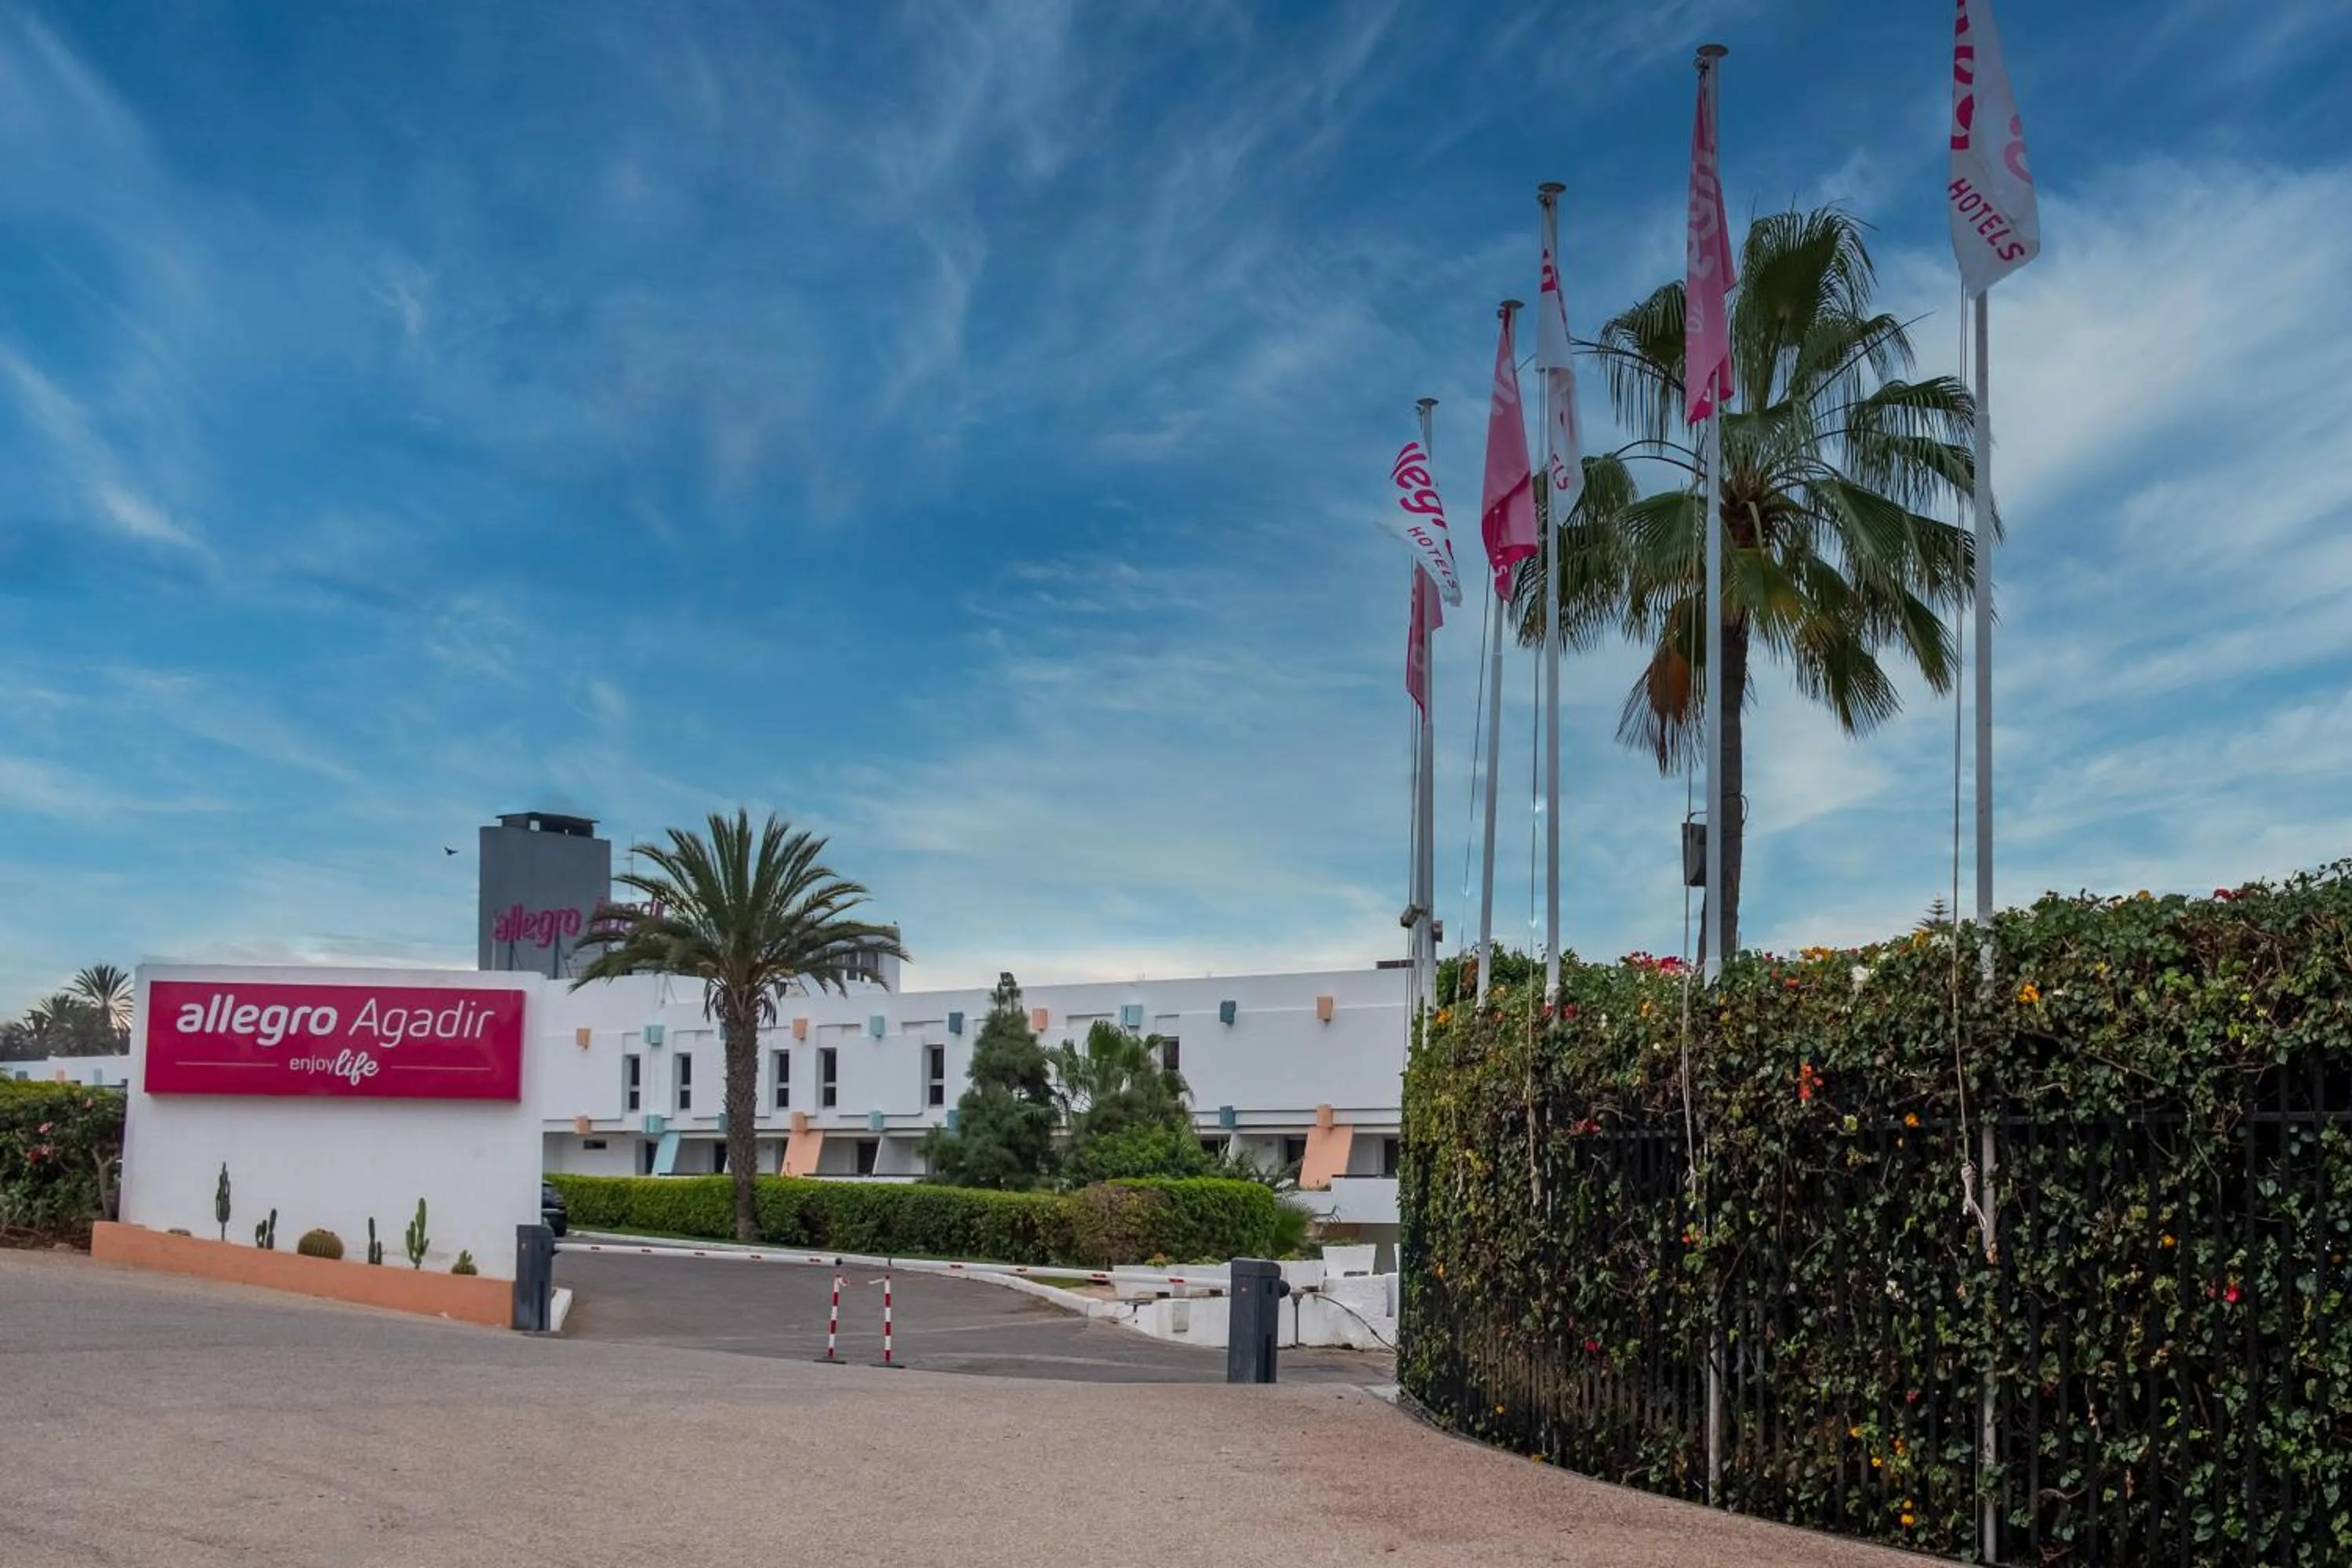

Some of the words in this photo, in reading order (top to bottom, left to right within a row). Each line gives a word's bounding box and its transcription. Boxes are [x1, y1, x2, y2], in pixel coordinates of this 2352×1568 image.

[1947, 178, 2025, 262] HOTELS
[493, 903, 582, 949] allegro
[176, 993, 338, 1047] allegro
[348, 997, 495, 1048] Agadir
